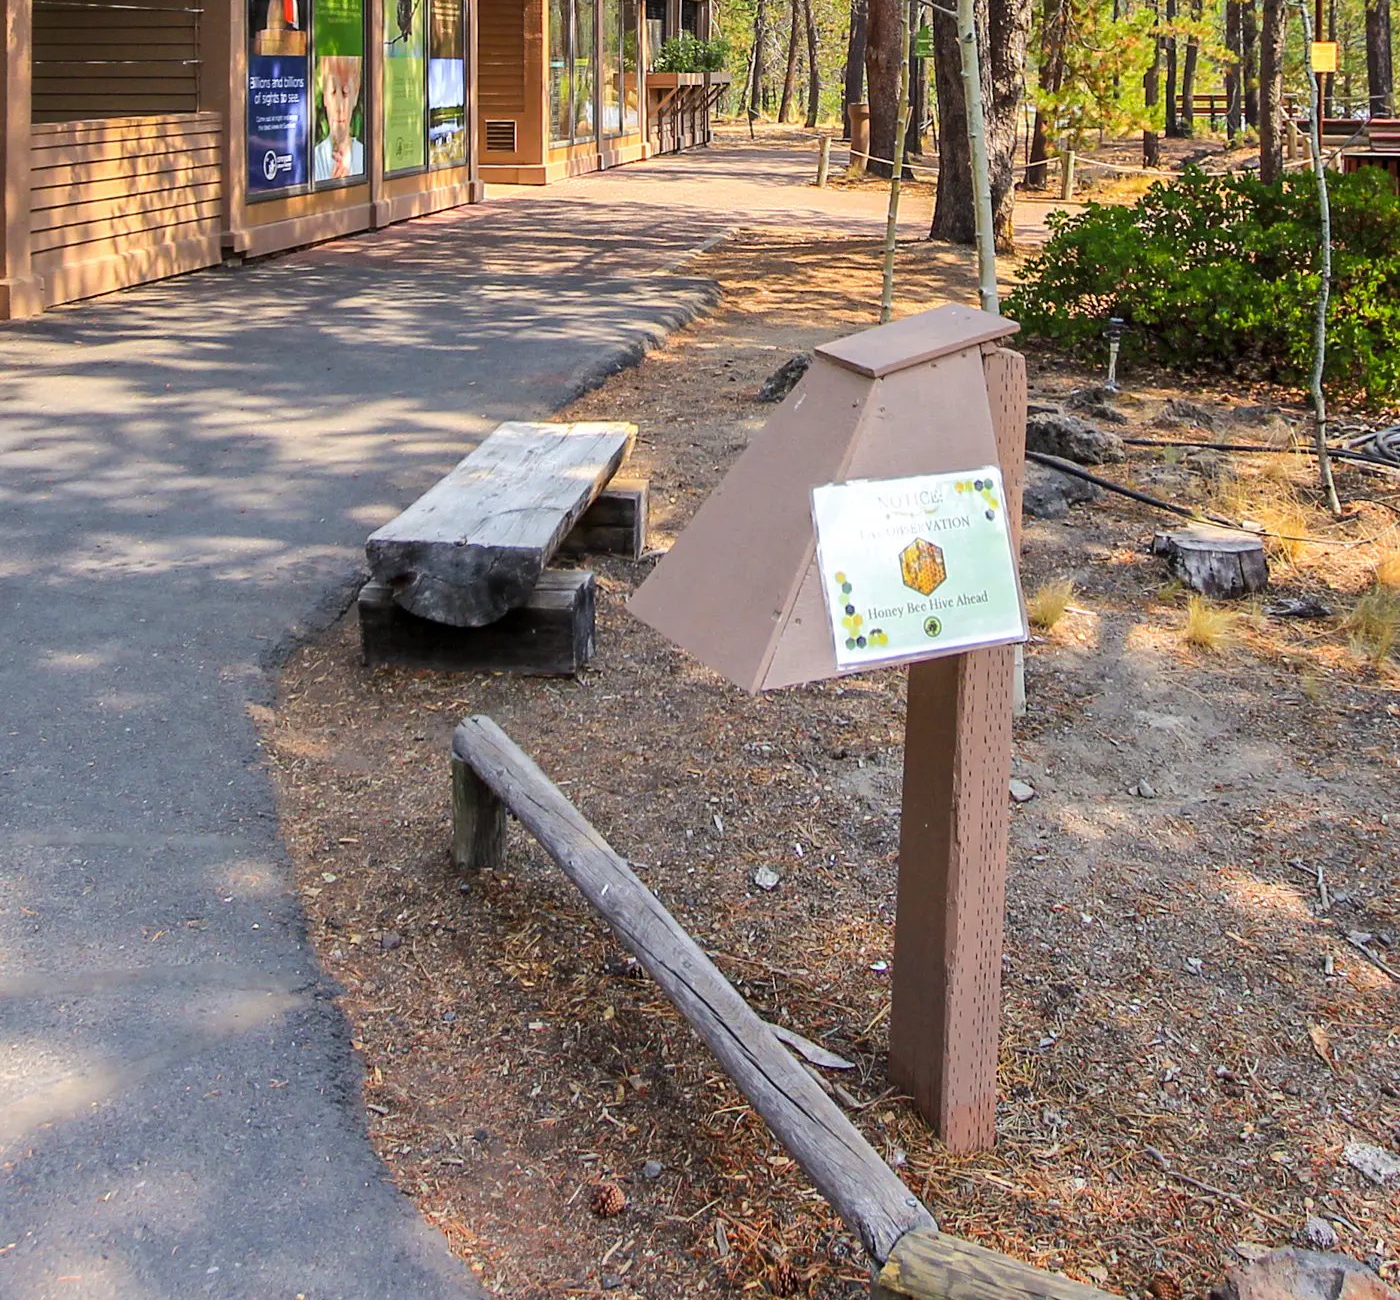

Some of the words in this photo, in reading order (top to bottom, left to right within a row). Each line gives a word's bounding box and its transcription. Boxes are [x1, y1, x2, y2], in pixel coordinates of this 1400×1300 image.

[250, 76, 271, 89] Billions
[272, 77, 282, 89] and
[283, 76, 304, 88] billions
[254, 91, 261, 104] of
[262, 91, 279, 106] sights
[280, 92, 288, 104] to
[877, 489, 943, 508] NOTICE:
[886, 515, 971, 537] OBSERVATION
[868, 607, 904, 620] Honey
[906, 603, 927, 614] Bee
[929, 598, 954, 611] Hive
[956, 590, 988, 607] Ahead
